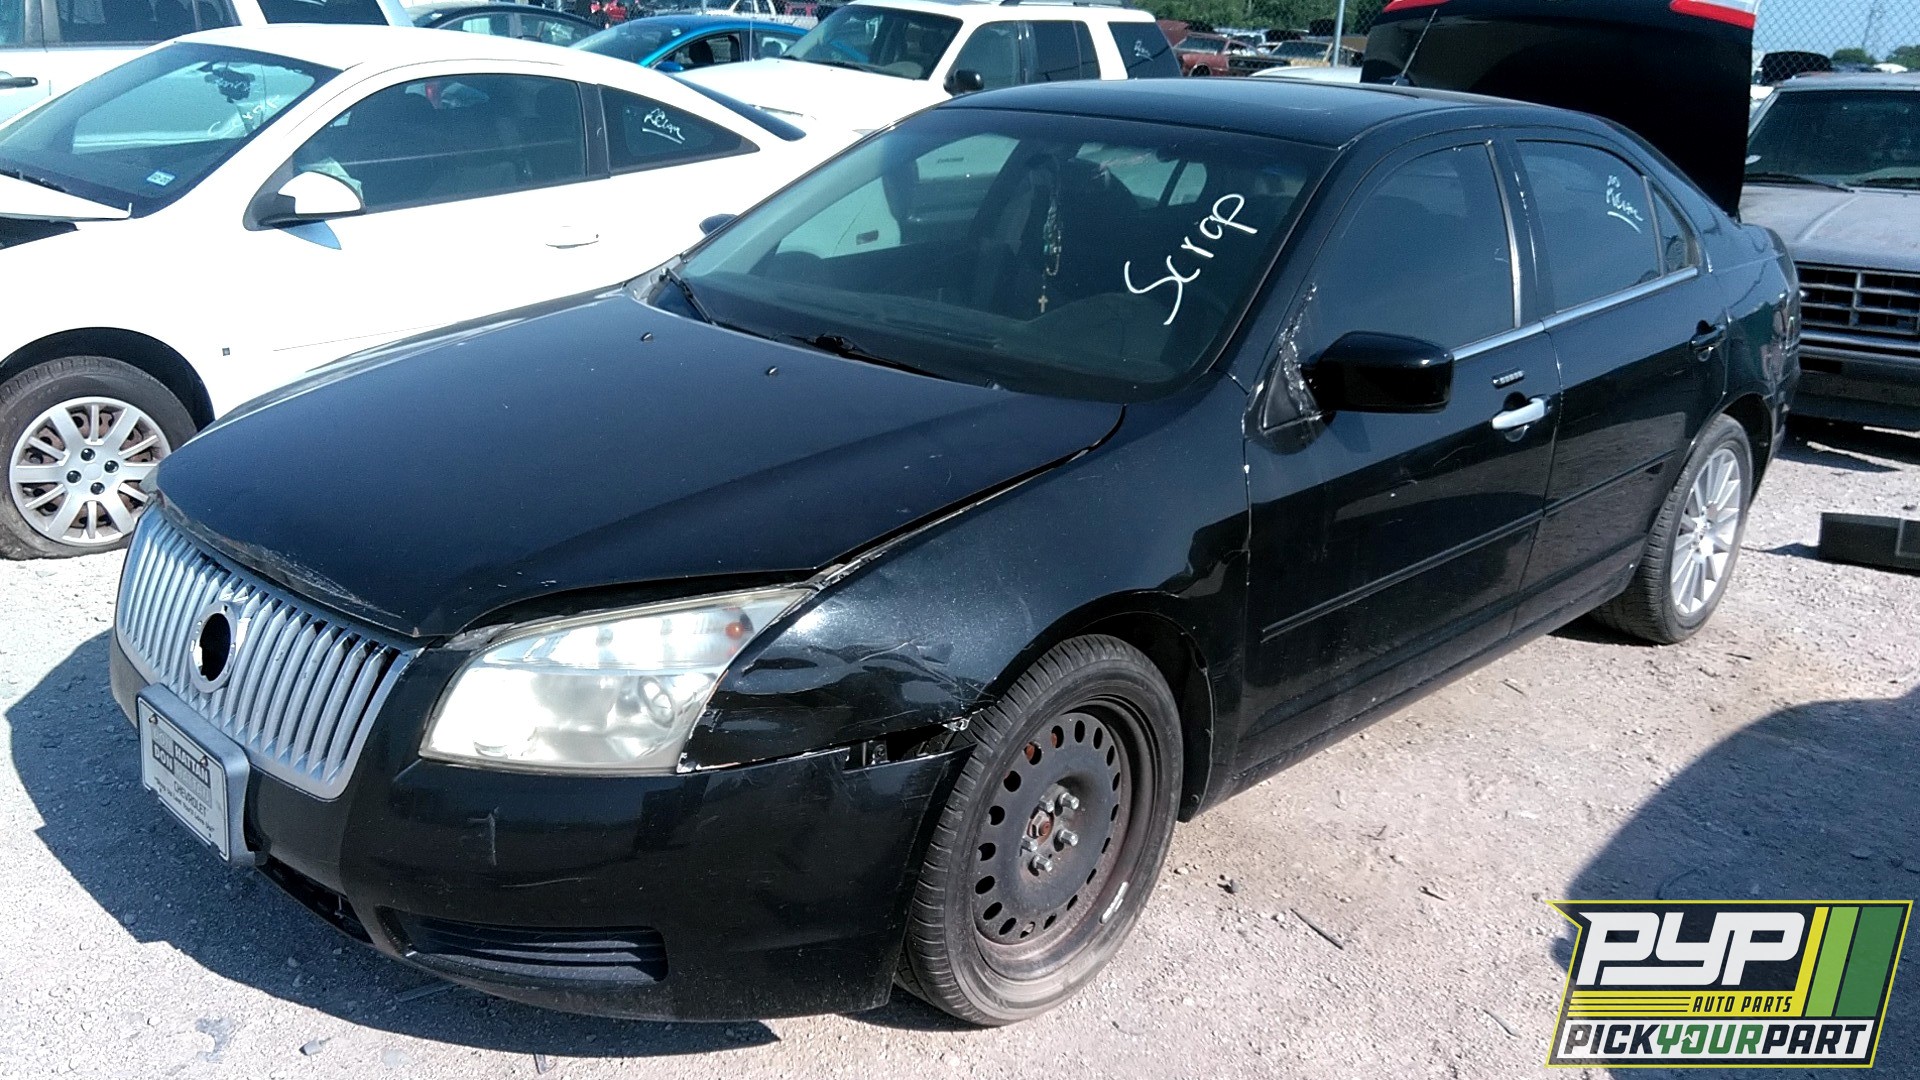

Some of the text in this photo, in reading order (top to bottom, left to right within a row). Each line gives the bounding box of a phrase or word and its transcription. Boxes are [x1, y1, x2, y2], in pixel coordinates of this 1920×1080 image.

[1124, 193, 1258, 326] Scrap
[154, 744, 173, 771] DON
[174, 744, 209, 784] HATTAN
[174, 781, 206, 818] CHEVROLET
